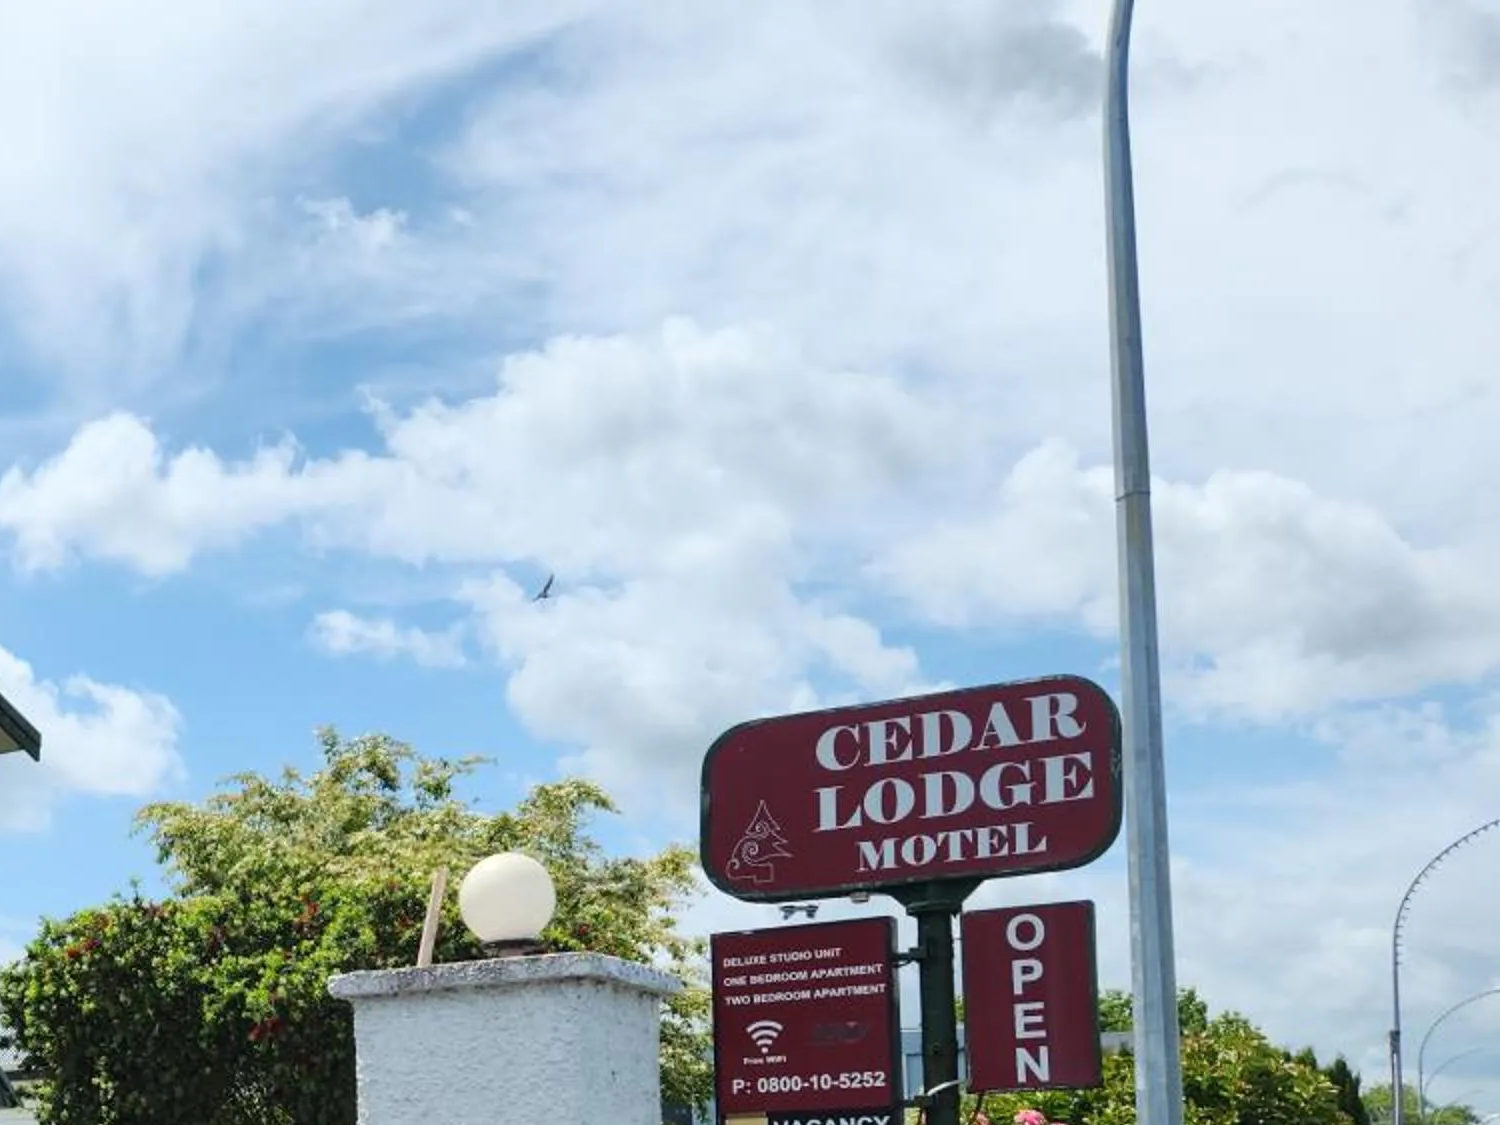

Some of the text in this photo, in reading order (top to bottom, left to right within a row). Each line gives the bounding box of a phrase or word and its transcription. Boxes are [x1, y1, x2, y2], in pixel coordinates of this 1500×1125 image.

[815, 692, 1087, 772] CEDAR
[812, 752, 1095, 832] LODGE
[858, 821, 1048, 872] MOTEL
[723, 947, 842, 968] DELUXE STUDIO UNIT
[723, 963, 883, 987] ONE BEDROOM APARTMENT
[725, 983, 886, 1006] TWO BEDROOM APARTMENT
[1006, 913, 1050, 1084] OPEN
[732, 1071, 886, 1095] P: 0800-10-5252
